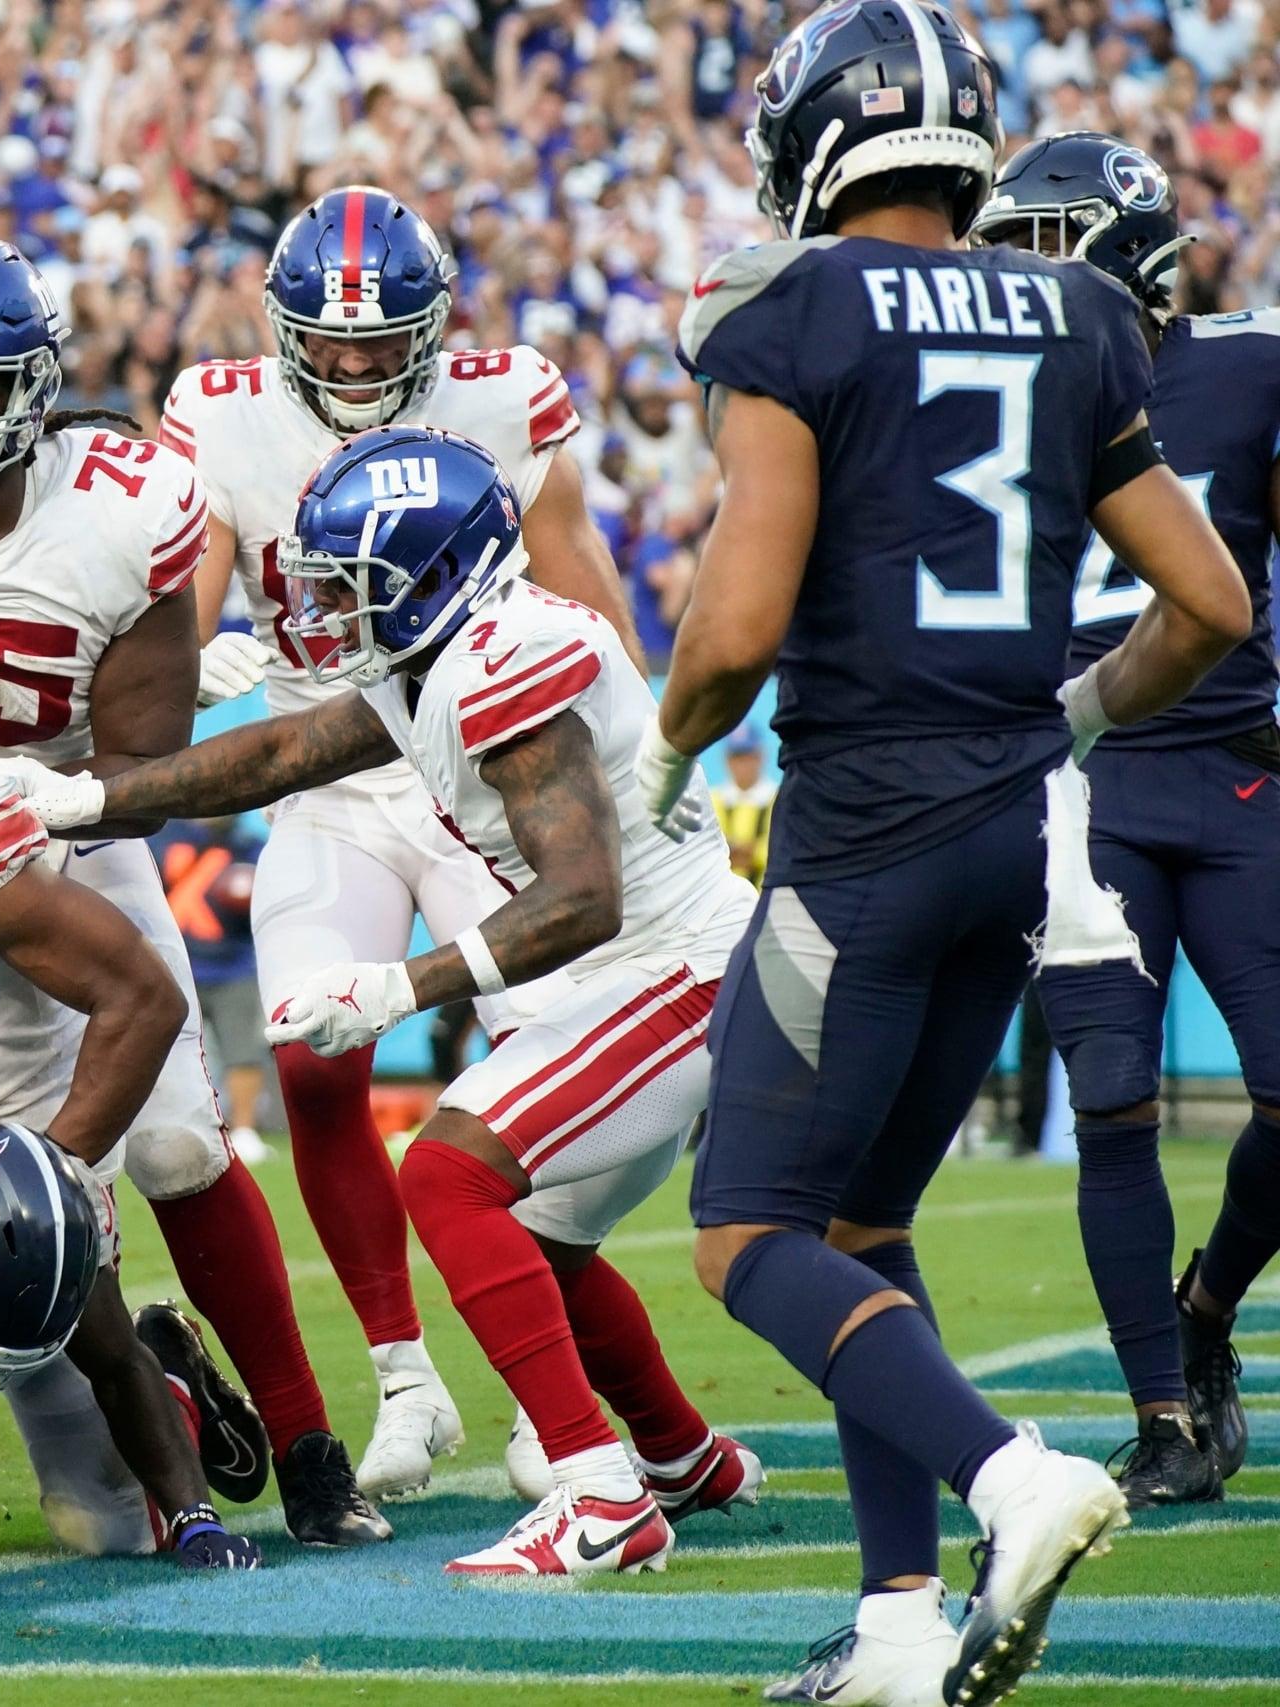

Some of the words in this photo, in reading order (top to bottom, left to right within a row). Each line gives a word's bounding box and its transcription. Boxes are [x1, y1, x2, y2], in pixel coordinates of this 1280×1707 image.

[886, 133, 980, 149] TENNESSEE
[323, 269, 381, 301] 85
[862, 267, 1070, 337] FARLEY
[73, 433, 159, 499] 75
[916, 350, 1044, 631] 3
